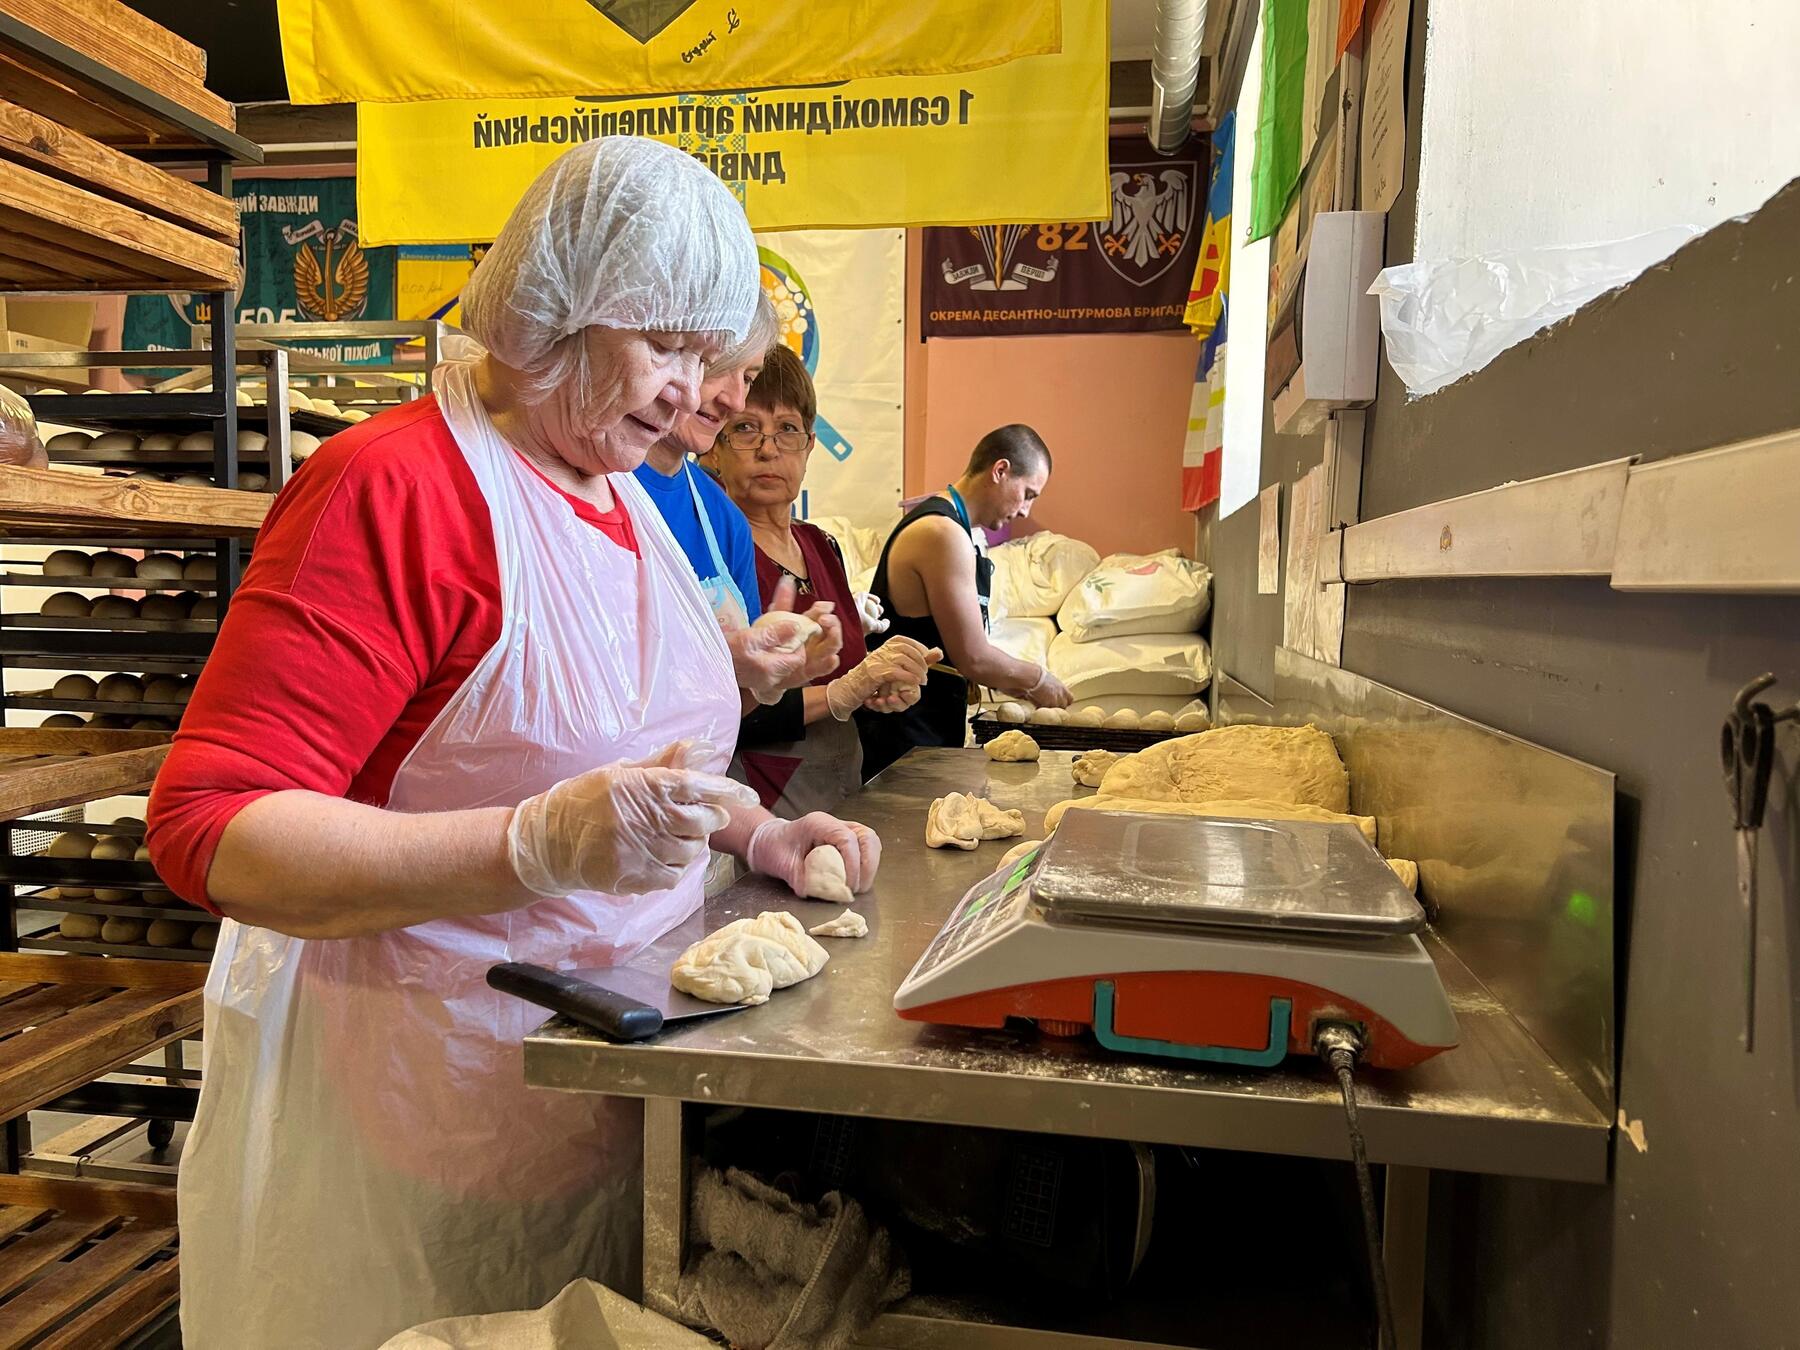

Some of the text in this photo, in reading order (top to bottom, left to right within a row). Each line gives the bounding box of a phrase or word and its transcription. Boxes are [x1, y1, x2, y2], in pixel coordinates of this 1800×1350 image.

[259, 194, 319, 215] ЗАВЖДИ
[1037, 222, 1089, 251] 82
[929, 304, 1184, 322] ОКРЕМА ДЕСАНТНО-ШТУРМОВА БРИГАД
